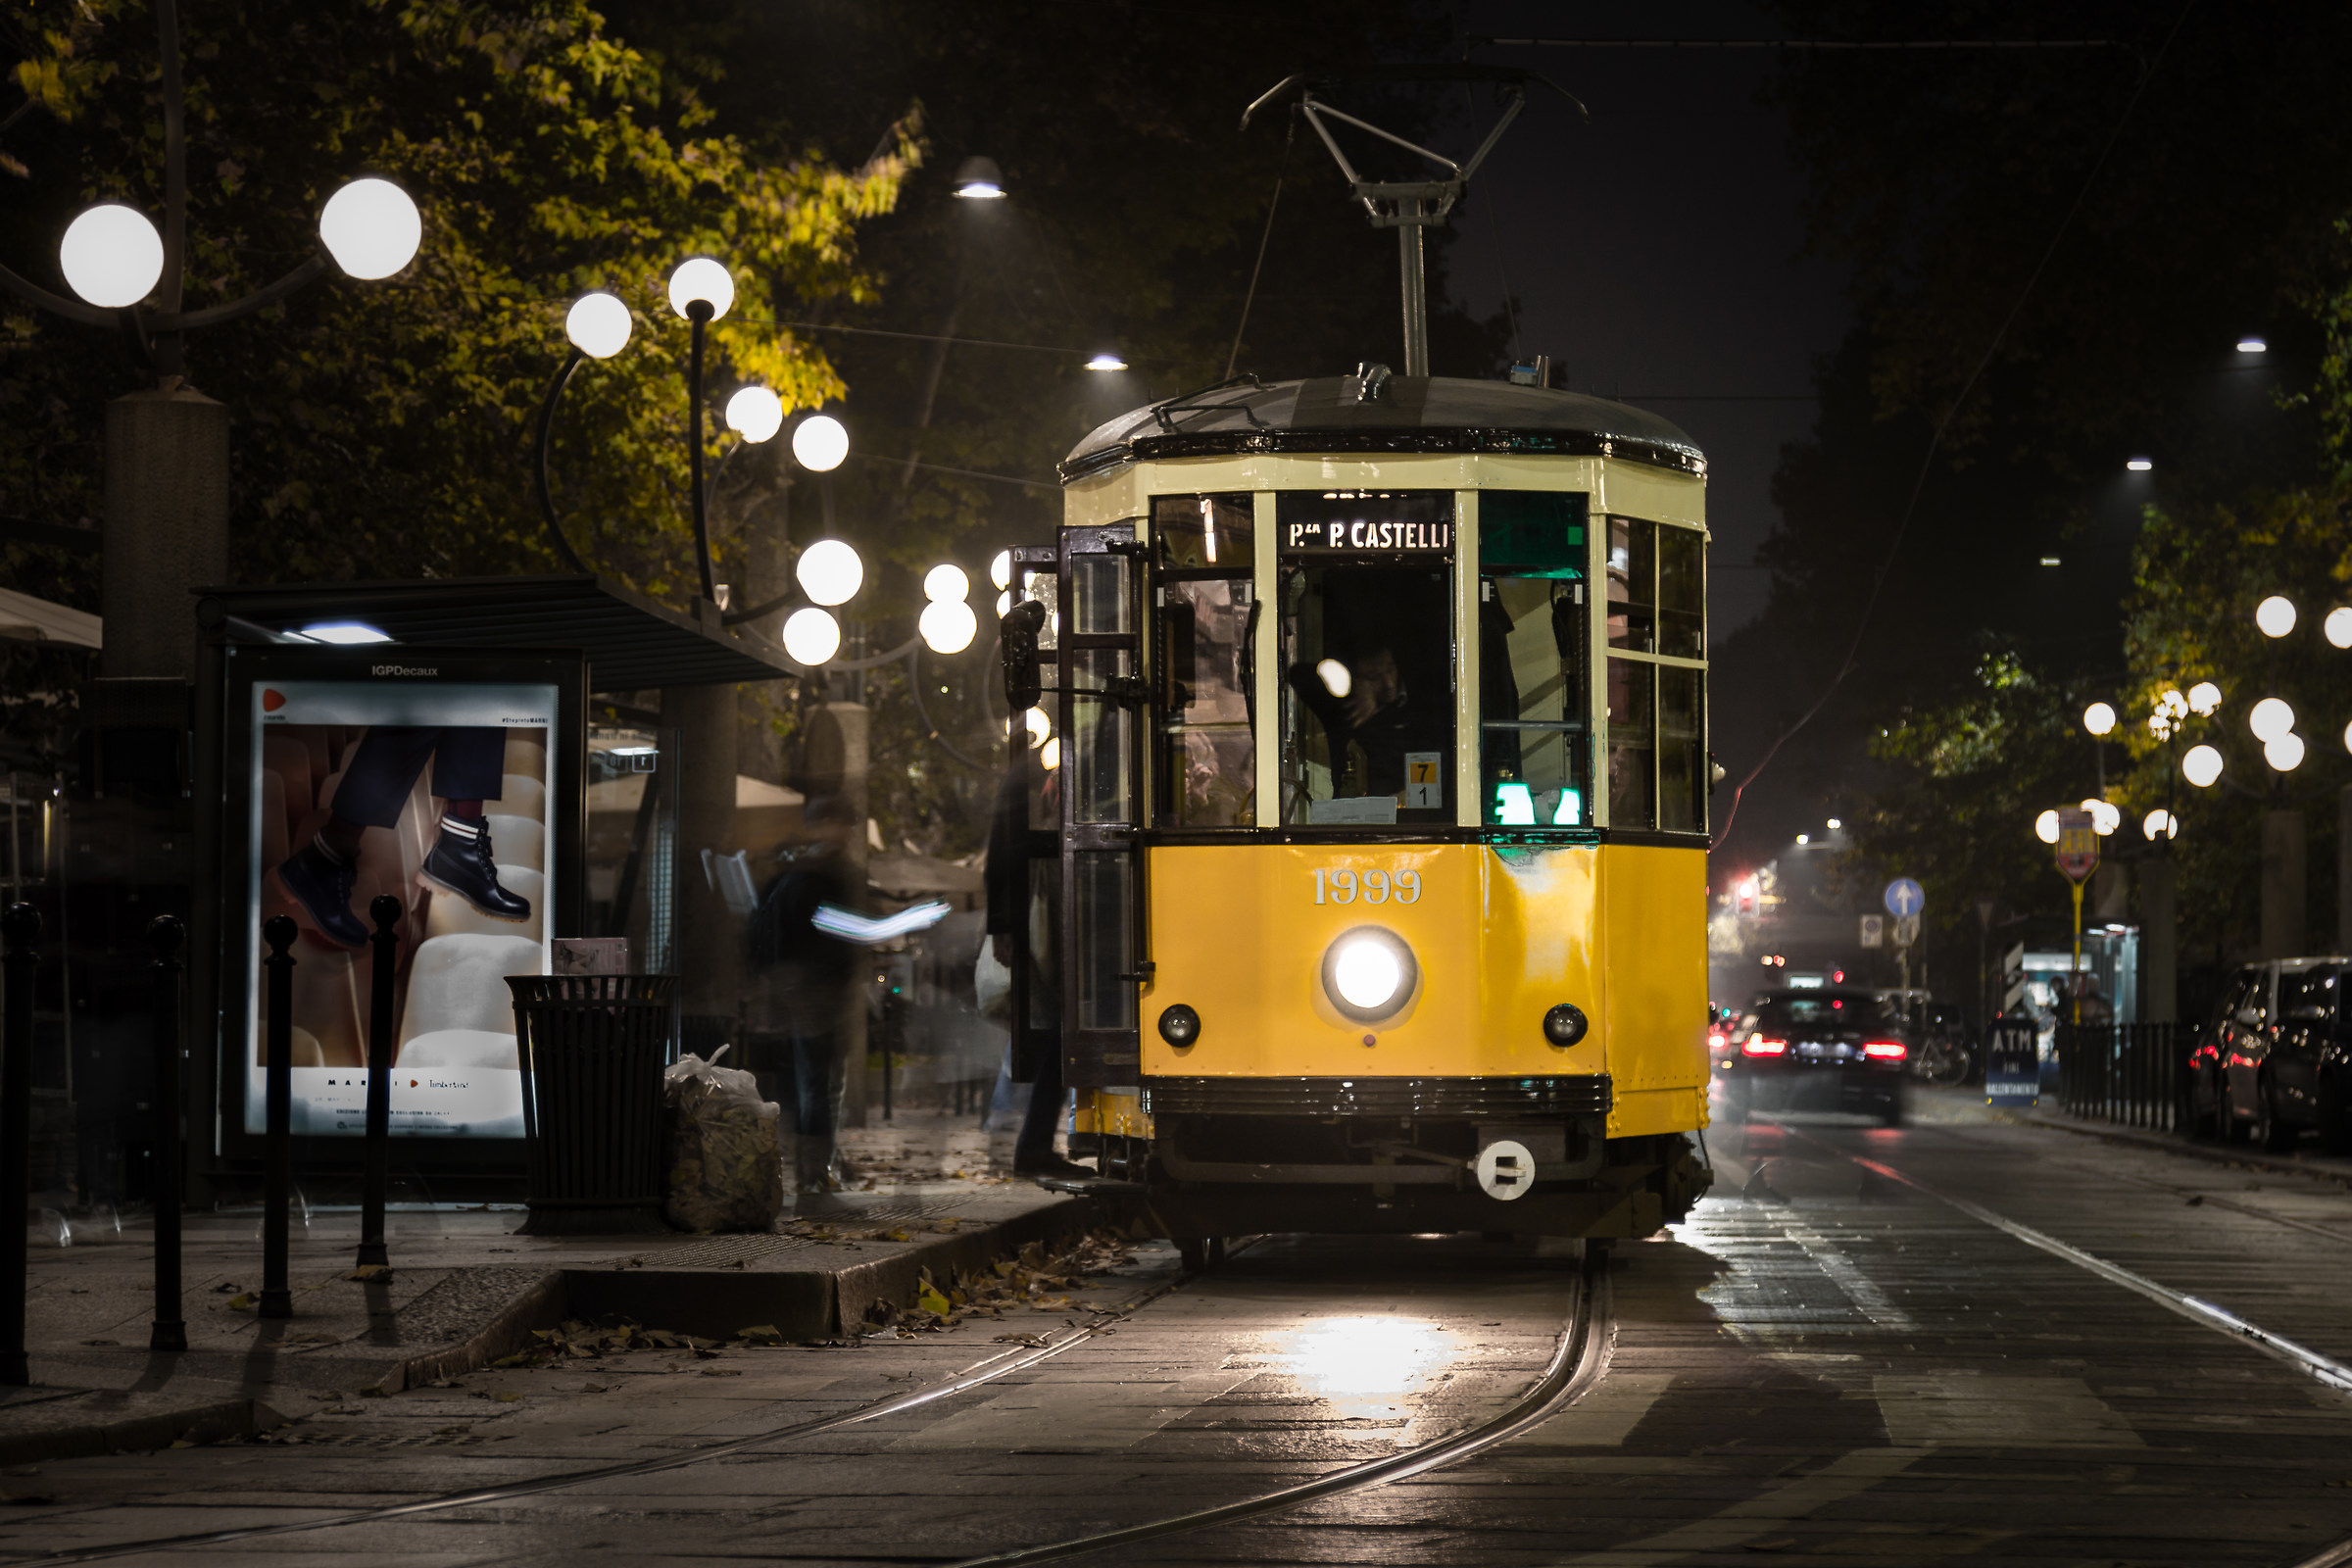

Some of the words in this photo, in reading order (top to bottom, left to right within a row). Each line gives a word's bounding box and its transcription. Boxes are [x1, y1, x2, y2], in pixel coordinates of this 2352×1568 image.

[1329, 522, 1344, 548] P.
[1350, 522, 1448, 549] CASTELLI
[371, 664, 439, 676] IGPDecaux
[1417, 764, 1429, 783] 7
[1419, 787, 1428, 806] 1
[1313, 869, 1422, 906] 1999
[1991, 1028, 2032, 1053] ATM
